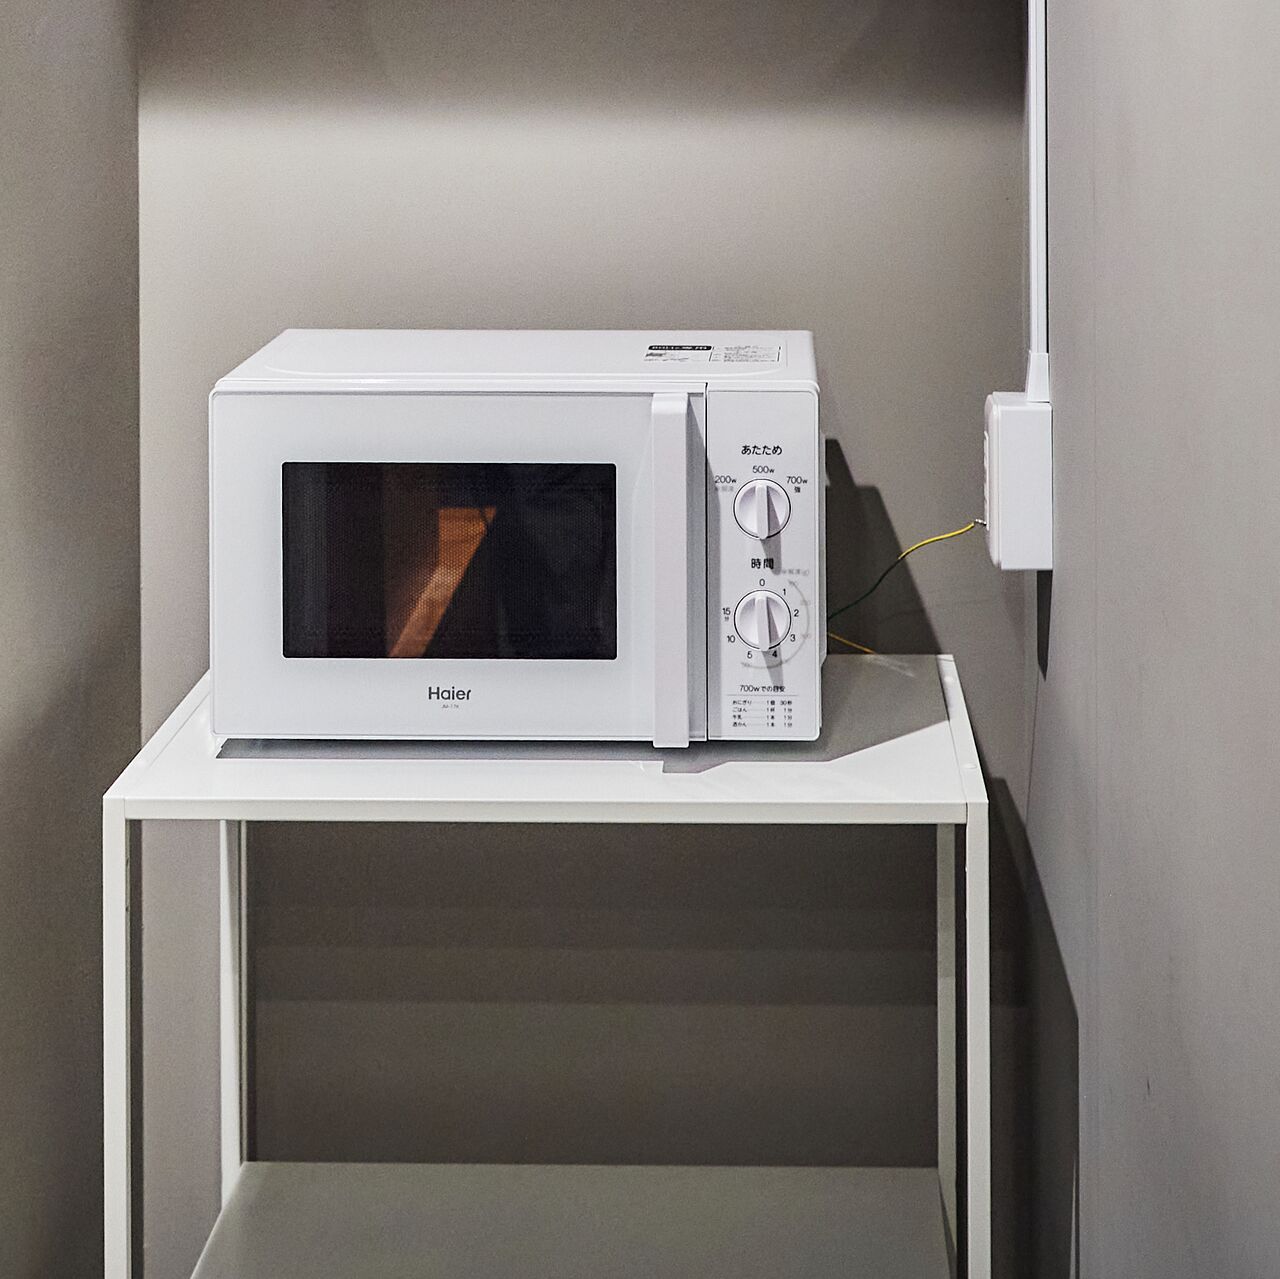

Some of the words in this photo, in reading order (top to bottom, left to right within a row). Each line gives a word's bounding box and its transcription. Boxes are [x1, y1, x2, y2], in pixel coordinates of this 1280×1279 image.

[741, 445, 783, 455] あたため
[751, 558, 774, 569] 時間
[759, 578, 766, 587] 0
[783, 588, 787, 596] 1
[722, 607, 731, 616] 15
[793, 609, 800, 618] 2
[727, 635, 736, 643] 10
[790, 634, 796, 642] 3
[747, 651, 753, 659] 5
[772, 650, 778, 658] 4
[428, 686, 471, 700] Haier
